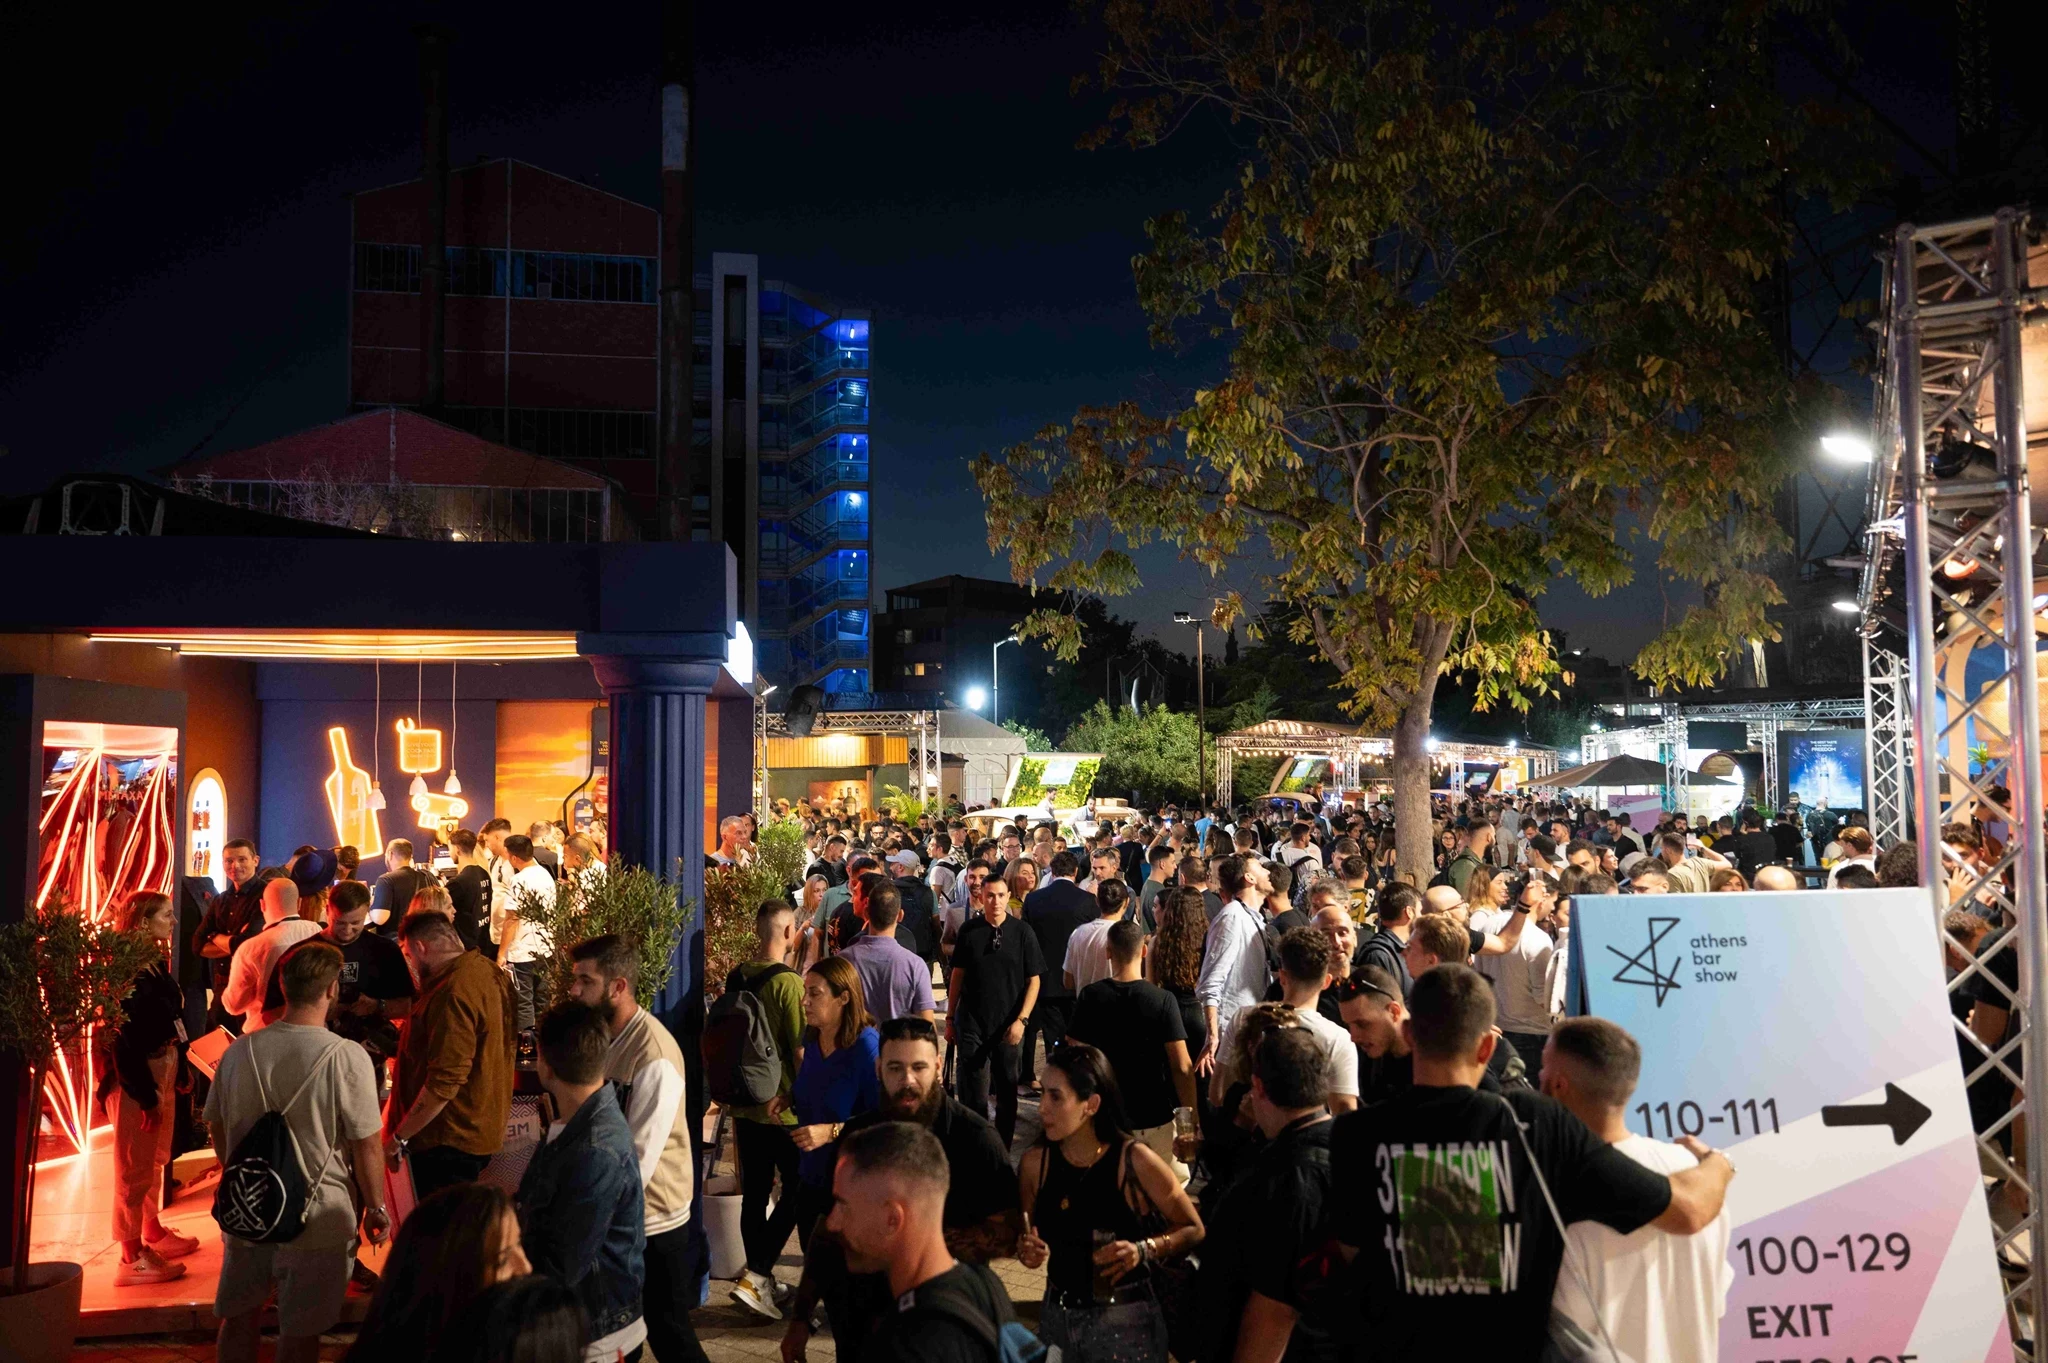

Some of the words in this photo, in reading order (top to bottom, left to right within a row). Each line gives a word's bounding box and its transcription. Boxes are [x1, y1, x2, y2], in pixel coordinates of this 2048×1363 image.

[1690, 933, 1747, 948] athens
[1692, 950, 1721, 965] bar
[1695, 967, 1737, 982] show
[1635, 1098, 1780, 1138] 110-111
[1737, 1232, 1911, 1276] 100-129
[1747, 1303, 1833, 1339] EXIT
